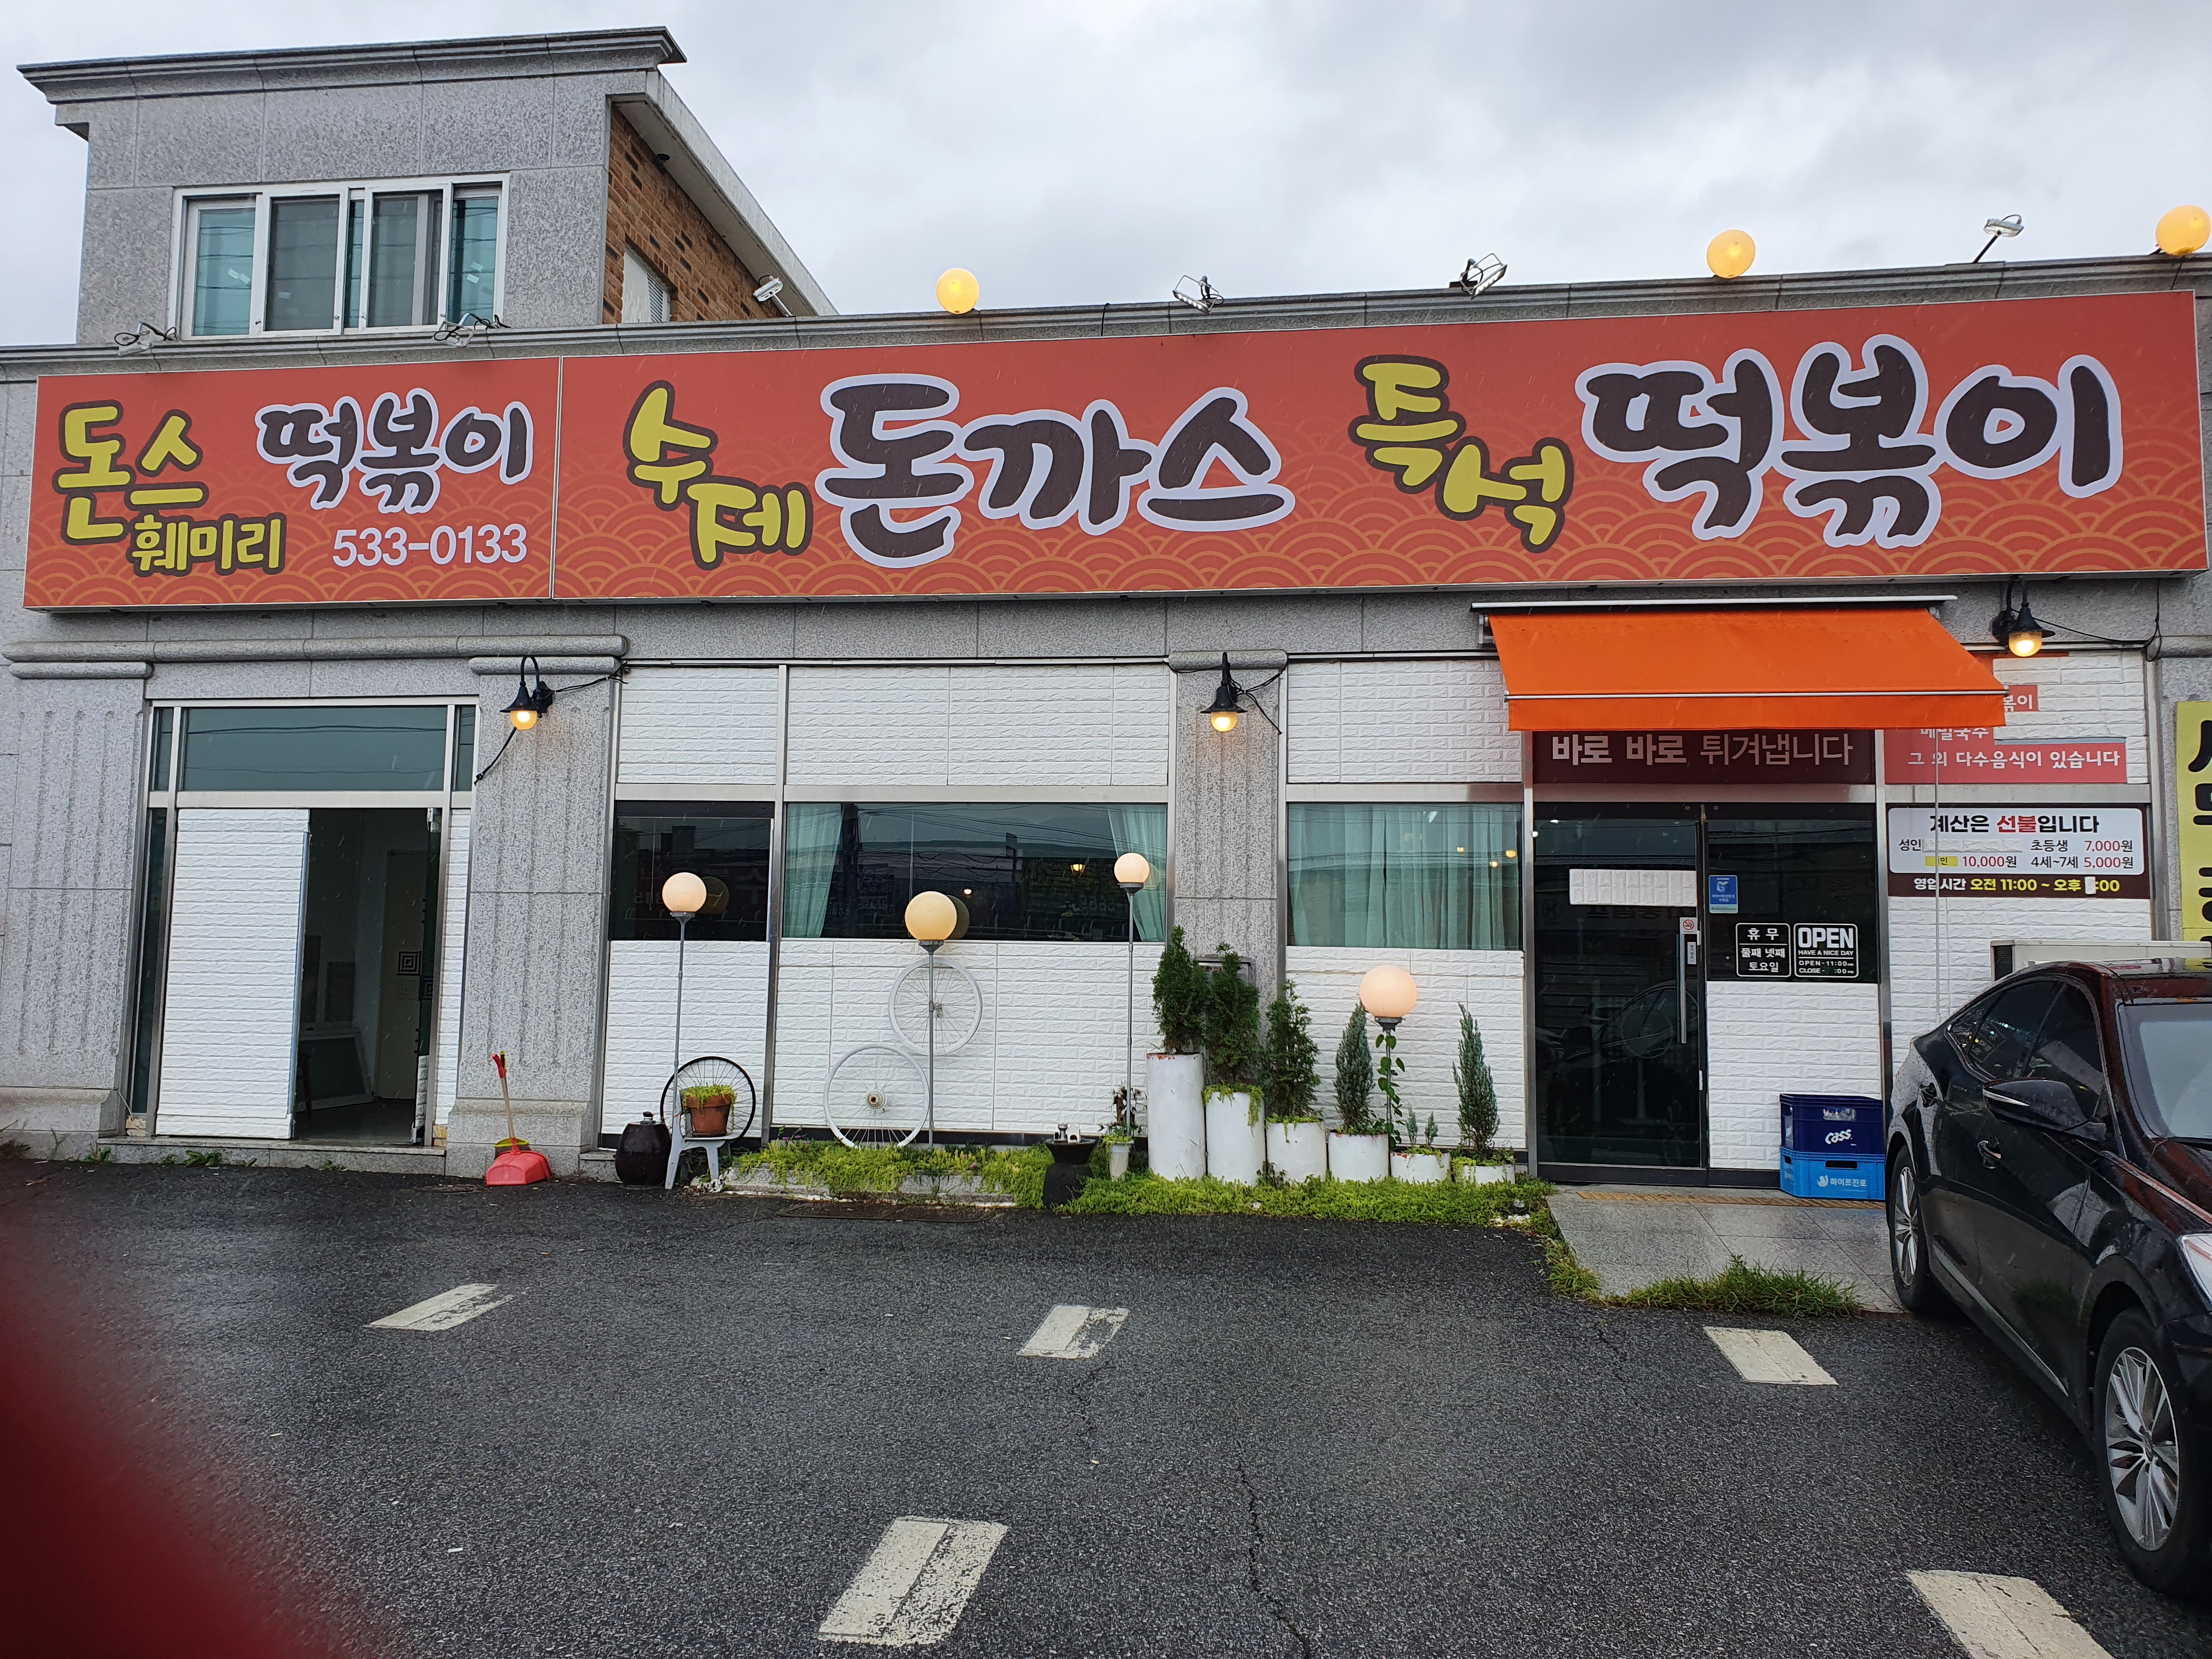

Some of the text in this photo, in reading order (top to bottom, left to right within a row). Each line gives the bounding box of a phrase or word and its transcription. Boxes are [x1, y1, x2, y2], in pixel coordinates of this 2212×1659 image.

[255, 388, 533, 514] 떡볶이
[1350, 334, 2124, 553] 즉석 떡볶이
[53, 399, 210, 544] 돈스
[623, 373, 1295, 571] 수제 돈까스
[126, 510, 287, 576] 훼미리
[332, 522, 527, 567] 533-0133
[1552, 733, 1853, 765] 바로 바로 튀겨냅니다
[1908, 751, 2120, 769] 그 외 다수음식이 있습니다
[1929, 815, 2100, 833] 계산은 선불입니다
[1898, 839, 2133, 853] 성인 초등생 7,000원
[1962, 856, 2017, 868] 10,000원
[2030, 856, 2079, 868] 4세~7세
[2084, 856, 2134, 869] 5,000원
[1914, 878, 1967, 891] 영업시간
[1970, 878, 1996, 891] 오전
[2000, 879, 2038, 891] 11:00
[2053, 879, 2081, 892] 오후
[2085, 879, 2120, 893] :00
[1798, 927, 1854, 949] OPEN
[1741, 947, 1786, 958] 둘째 넷째
[1748, 962, 1779, 973] 토요일
[1830, 1178, 1867, 1187] 하이트진로
